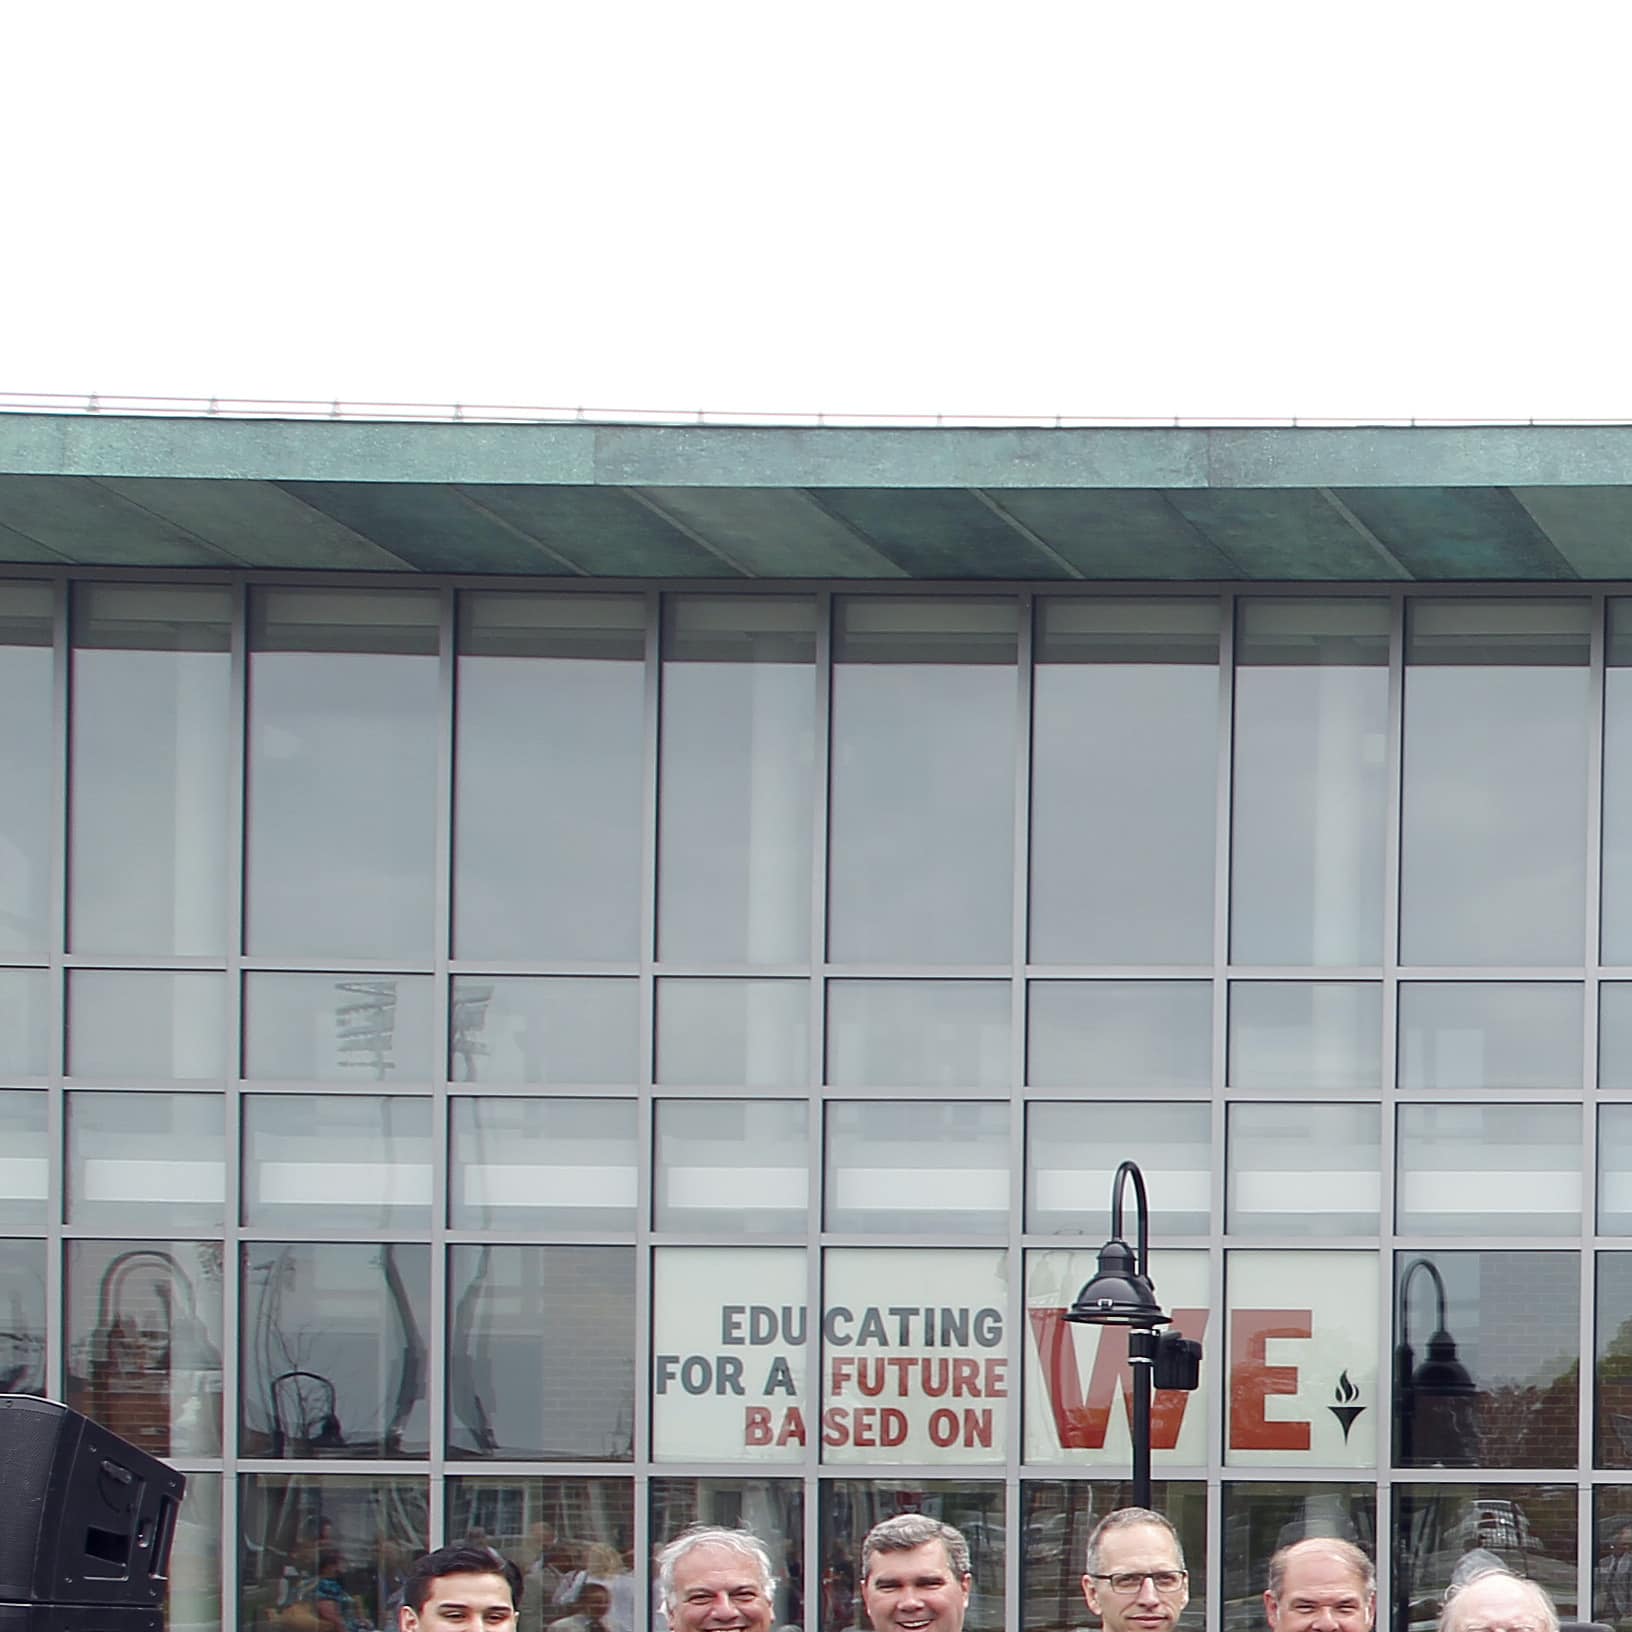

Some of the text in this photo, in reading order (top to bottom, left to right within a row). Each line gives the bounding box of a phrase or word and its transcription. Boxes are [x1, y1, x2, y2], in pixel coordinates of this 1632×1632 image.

[722, 1306, 1003, 1347] EDUCATING
[656, 1355, 1008, 1398] FOR A FUTURE
[1028, 1308, 1312, 1450] WE
[745, 1406, 992, 1448] BASED ON
